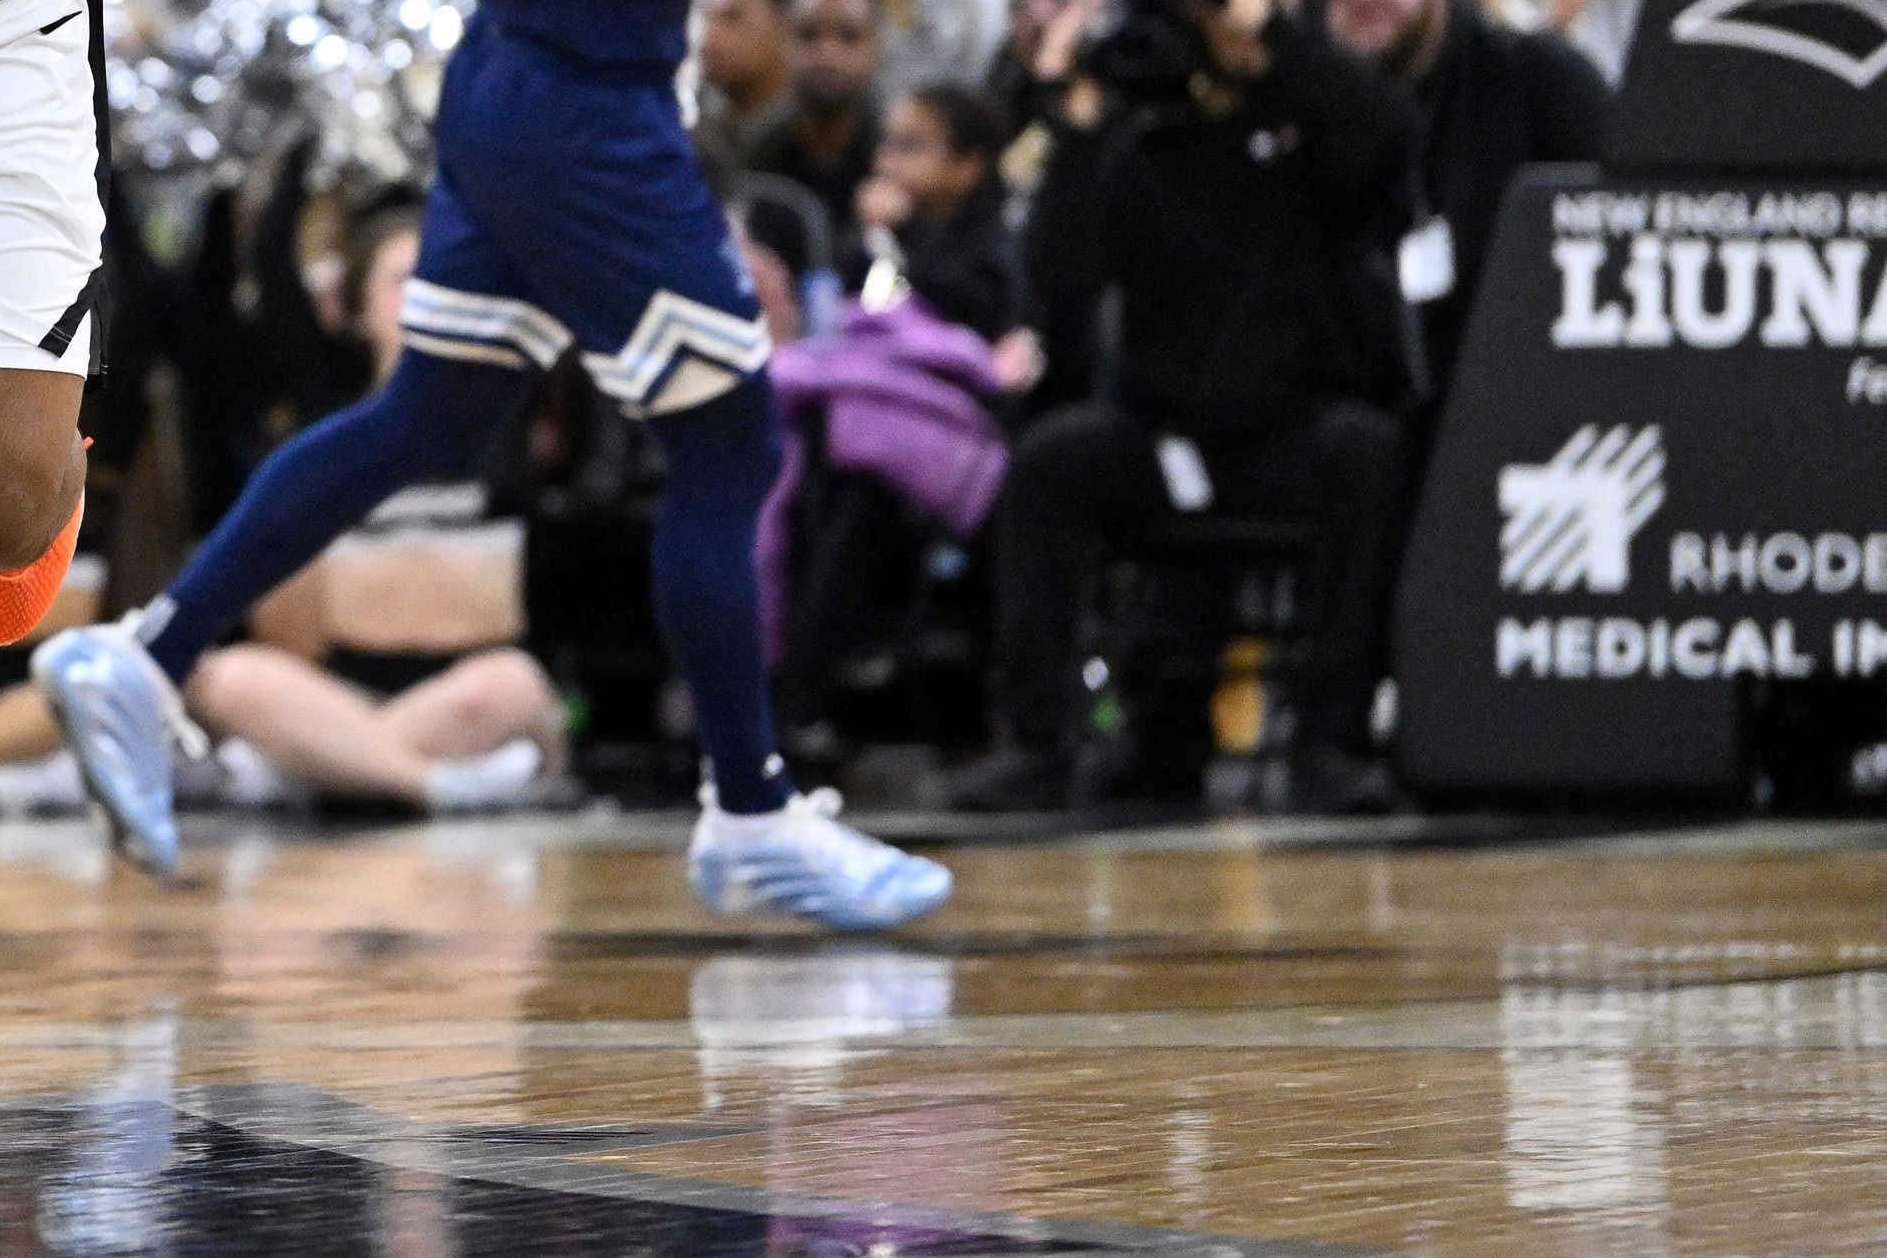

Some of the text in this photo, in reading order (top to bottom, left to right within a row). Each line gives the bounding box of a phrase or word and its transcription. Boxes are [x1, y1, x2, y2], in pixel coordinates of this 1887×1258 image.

[1552, 191, 1650, 236] NEW
[1653, 191, 1844, 239] ENGLAND
[1550, 236, 1887, 349] LiUN
[1494, 615, 1816, 680] MEDICAL
